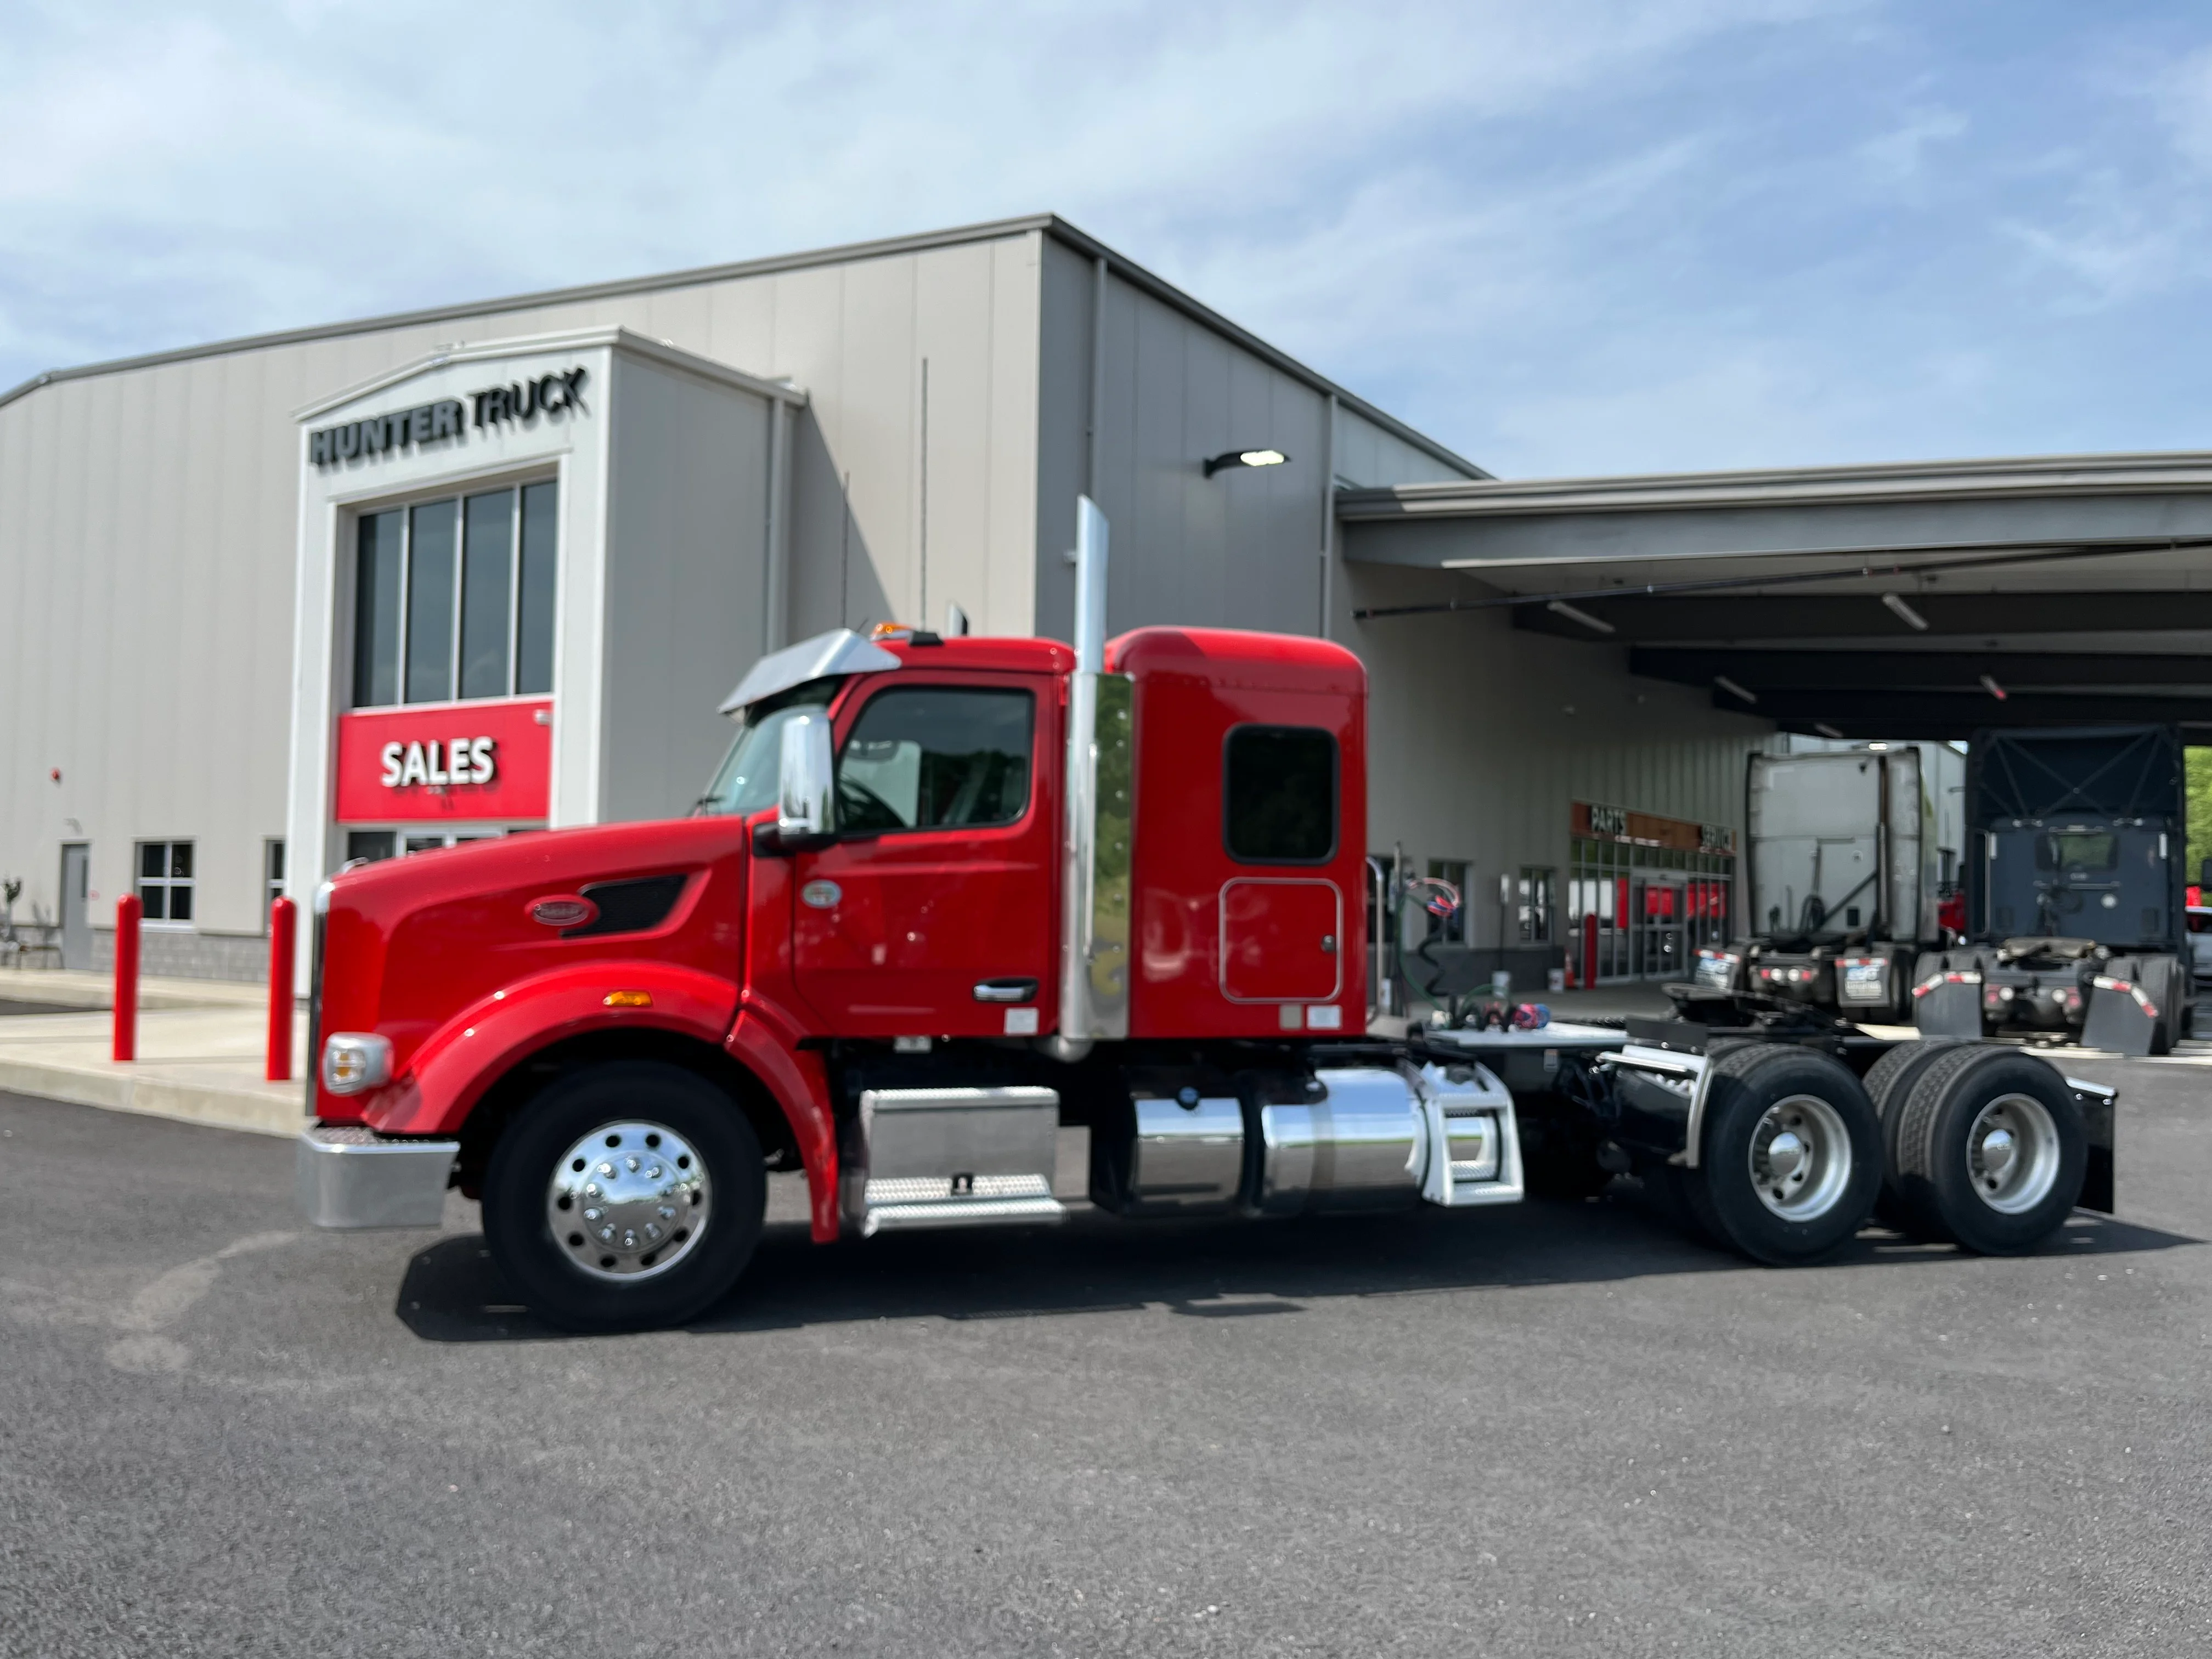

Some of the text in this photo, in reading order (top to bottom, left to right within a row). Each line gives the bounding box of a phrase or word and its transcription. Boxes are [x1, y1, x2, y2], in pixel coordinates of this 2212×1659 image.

[311, 367, 589, 465] HUNTER TRUCK
[381, 736, 495, 787] SALES
[1592, 807, 1627, 836] PARTS
